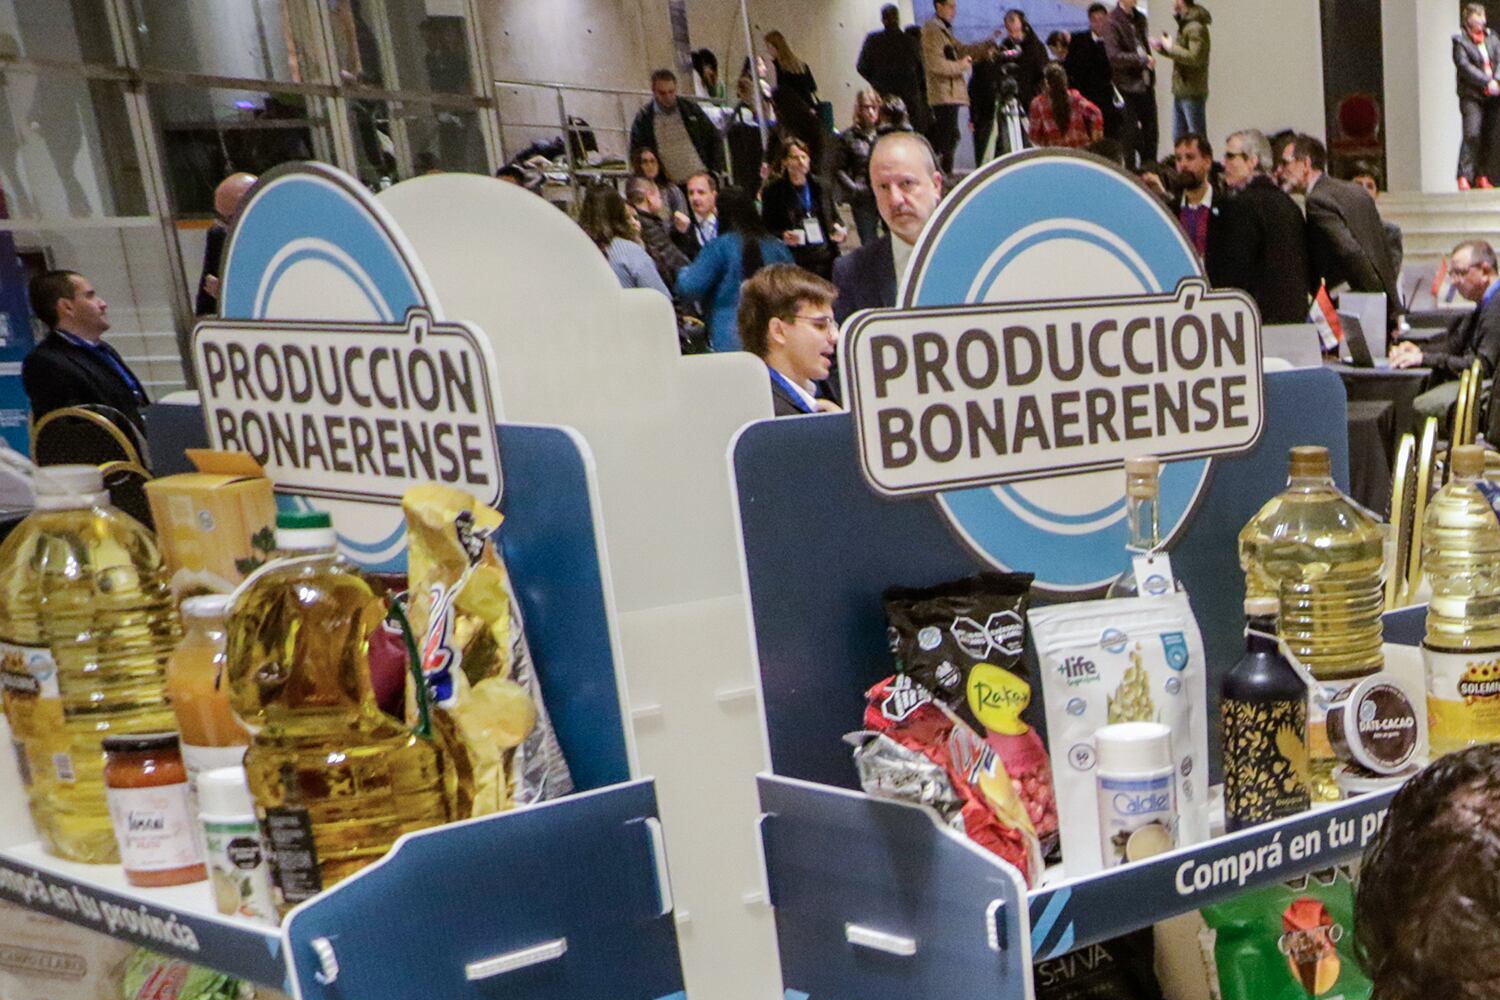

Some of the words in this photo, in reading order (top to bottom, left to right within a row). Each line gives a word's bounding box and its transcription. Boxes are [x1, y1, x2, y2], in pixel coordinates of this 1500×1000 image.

[202, 324, 478, 413] PRODUCCIÓN
[871, 297, 1246, 398] PRODUCCIÓN
[216, 408, 488, 486] BONAERENSE
[876, 375, 1249, 470] BONAERENSE
[1175, 831, 1284, 896] Comprá
[1289, 829, 1321, 862] en
[1327, 817, 1355, 848] tu
